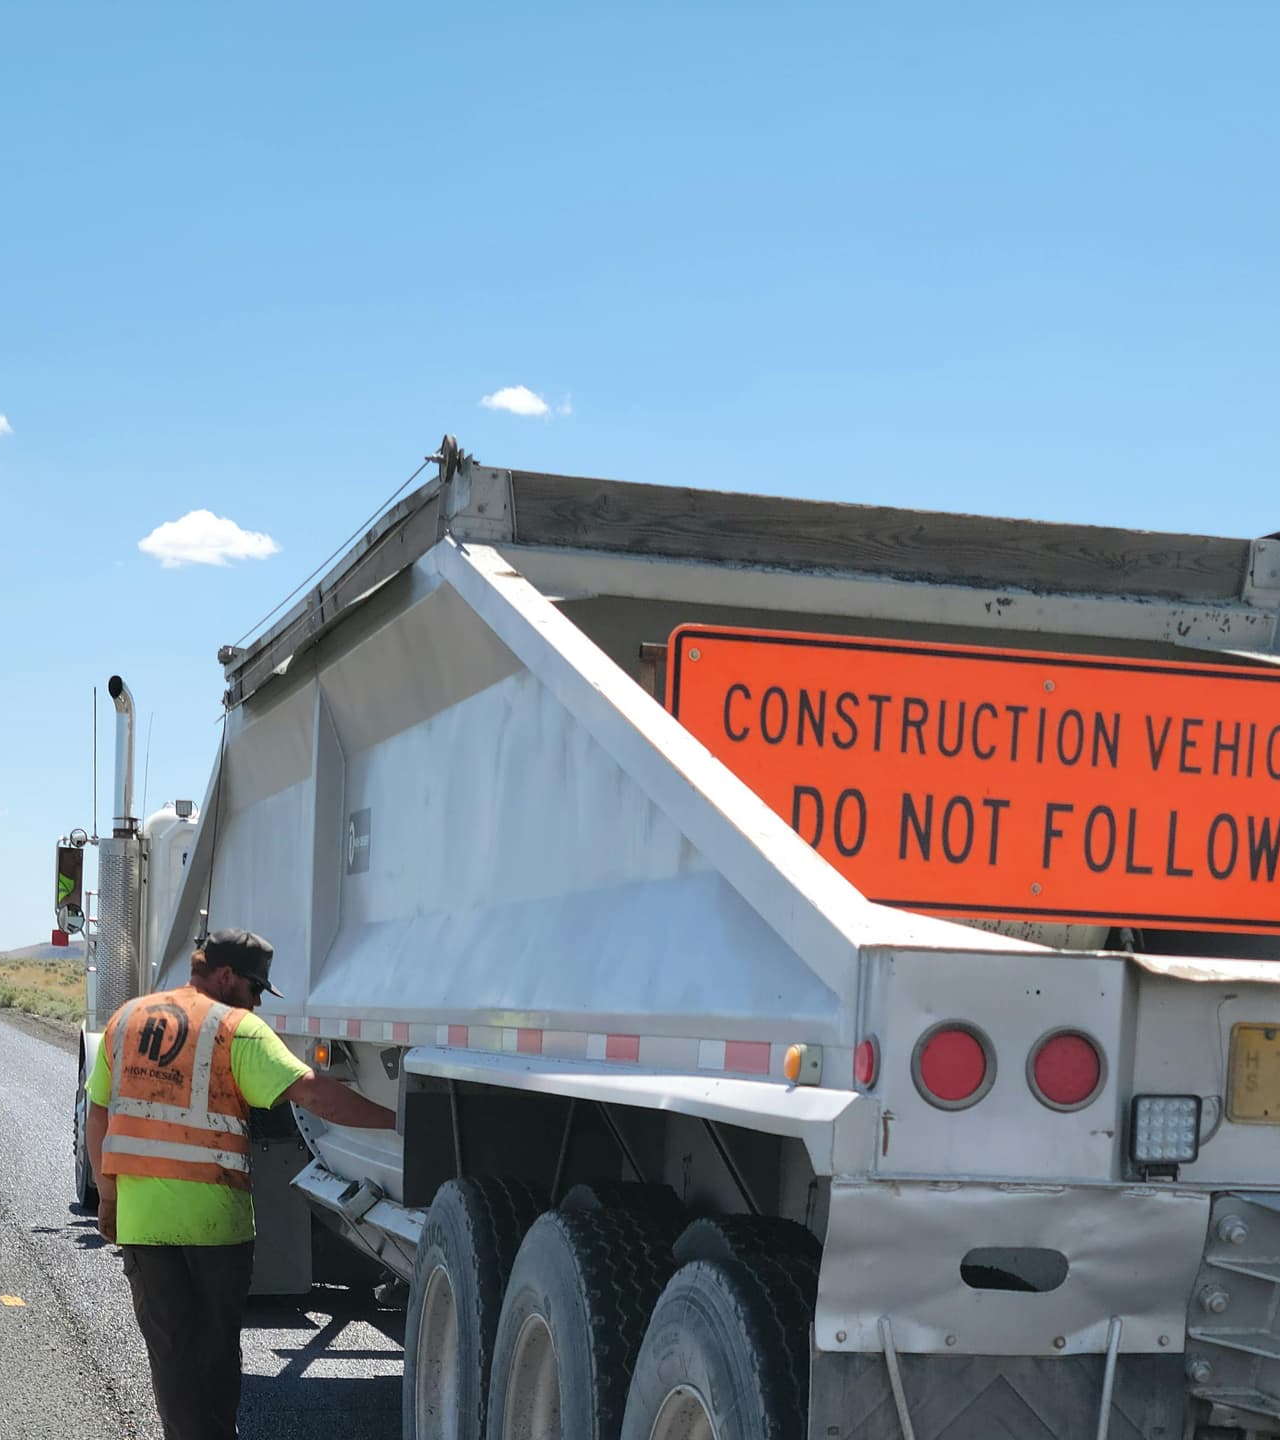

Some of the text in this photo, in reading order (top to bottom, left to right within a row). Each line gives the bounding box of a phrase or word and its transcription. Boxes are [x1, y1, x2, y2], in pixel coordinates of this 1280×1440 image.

[724, 684, 1120, 768] CONSTRUCTION
[791, 785, 867, 858] DO
[899, 793, 1010, 866] NOT
